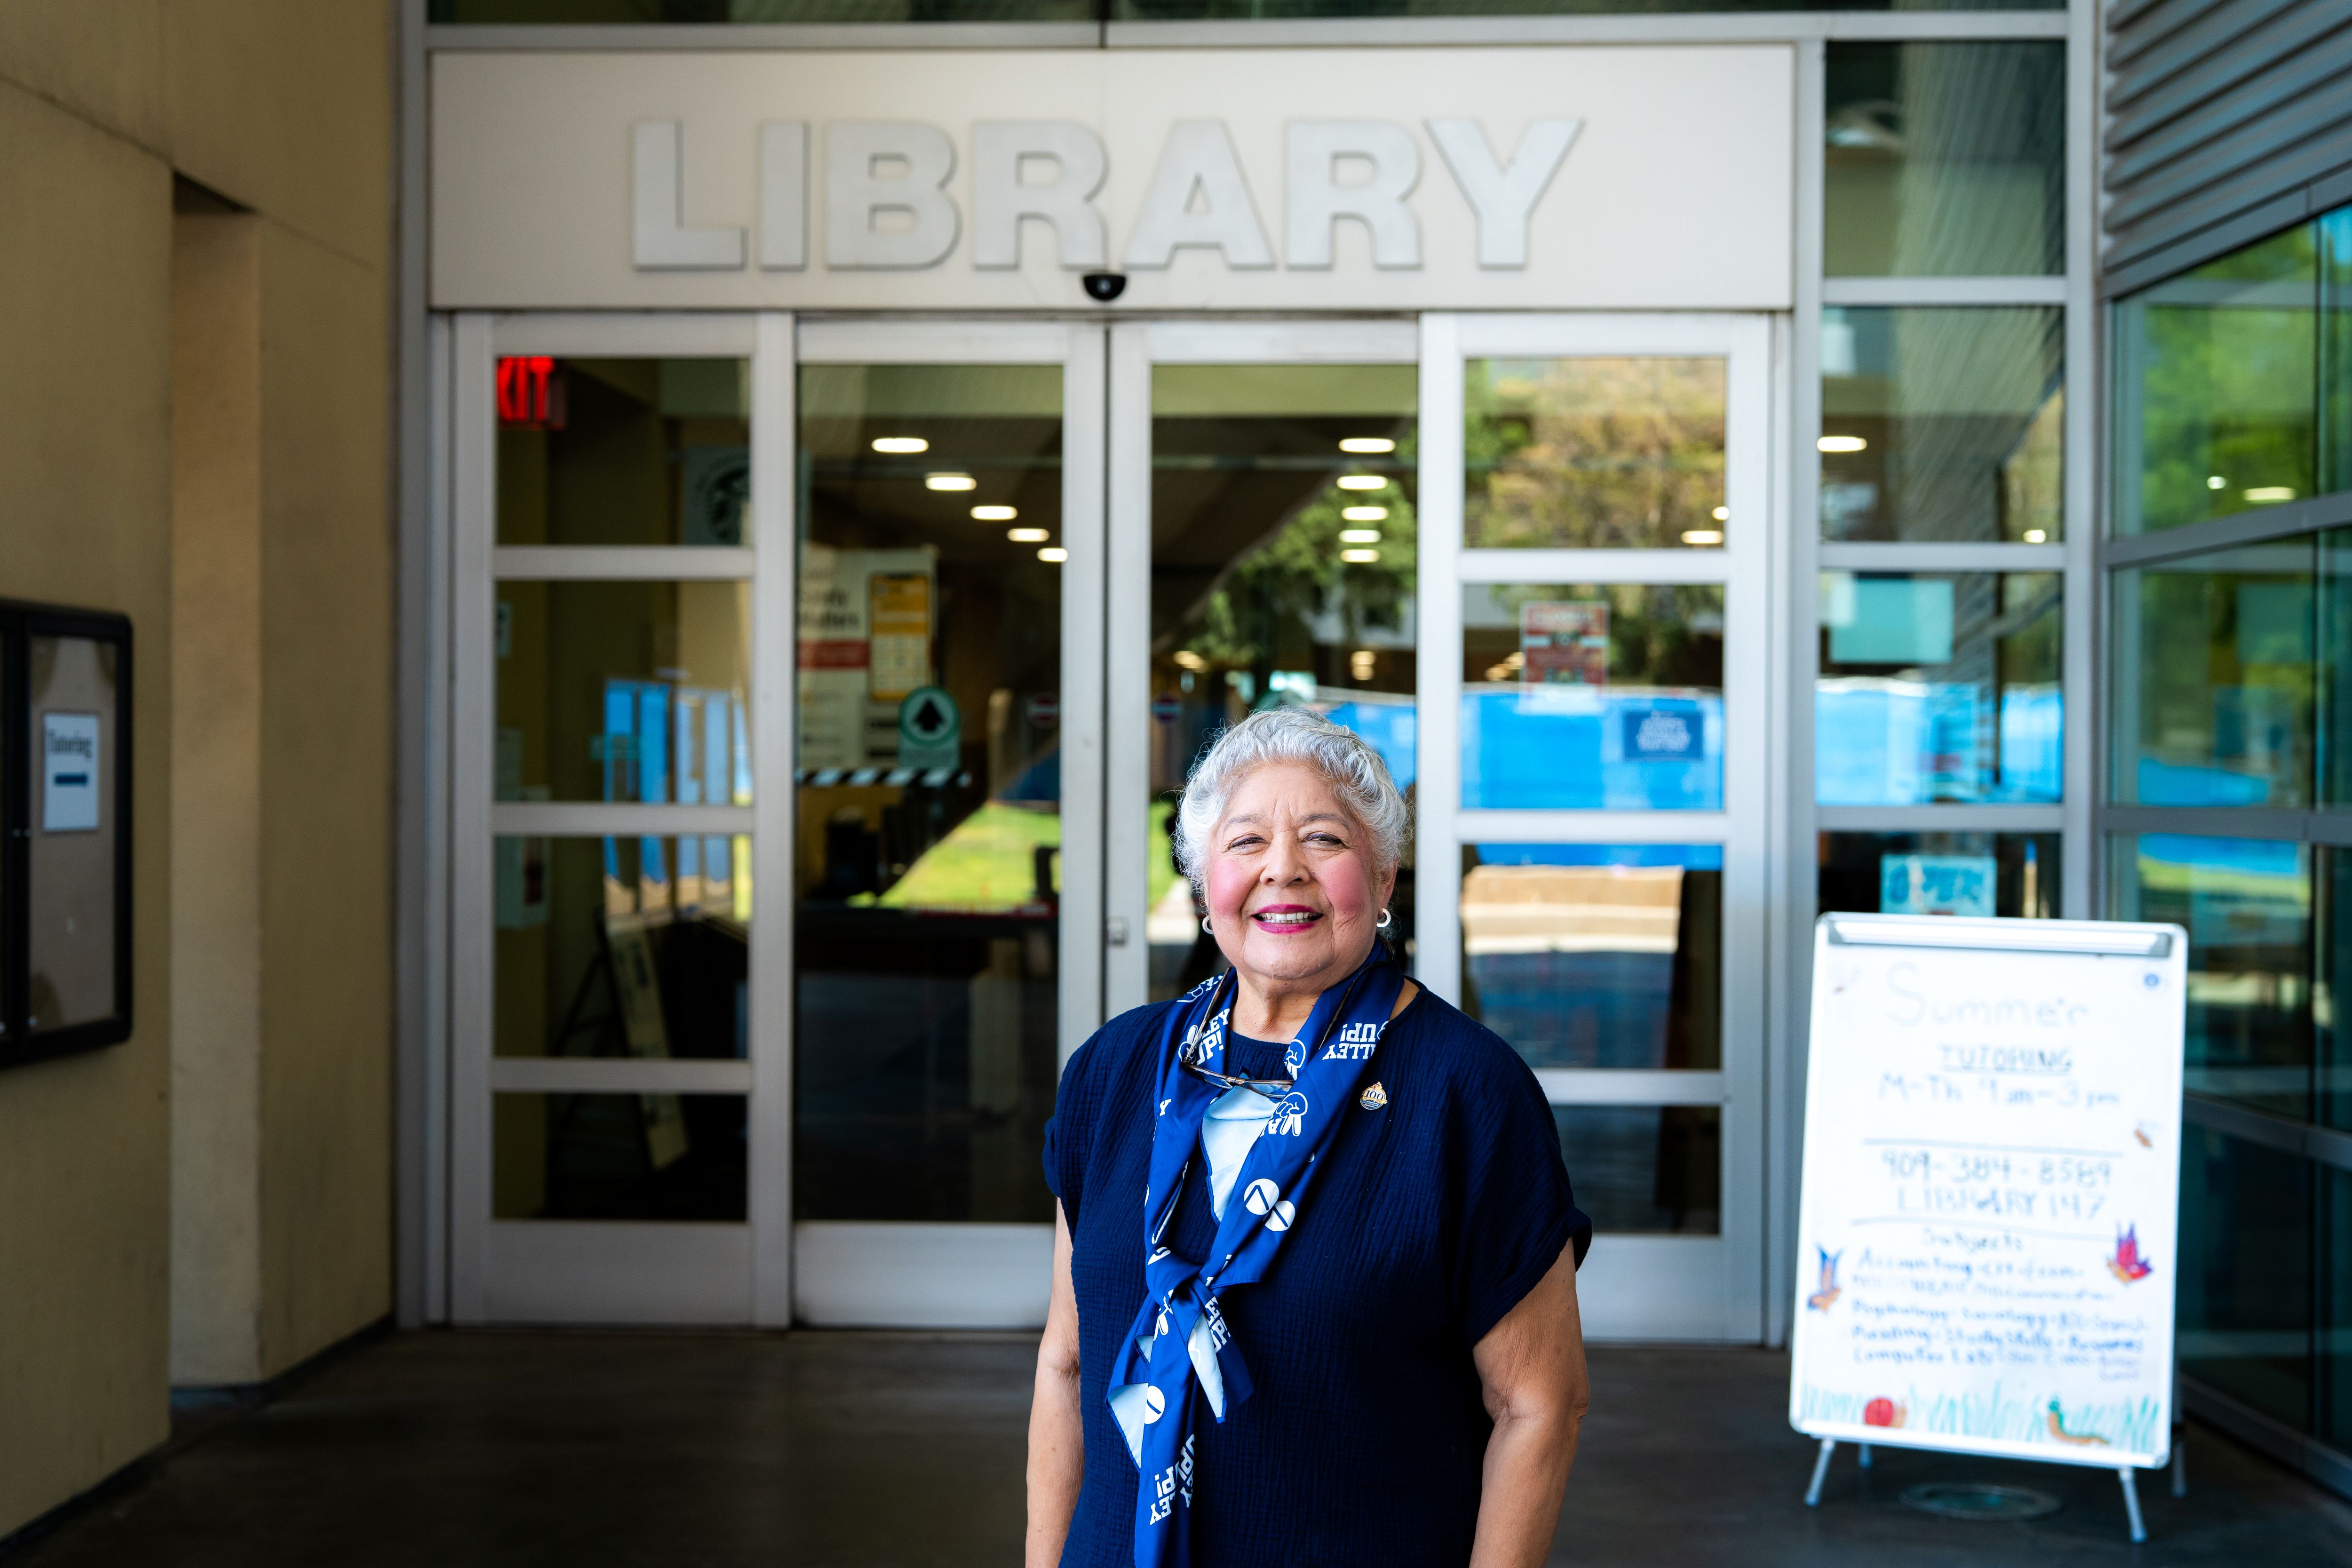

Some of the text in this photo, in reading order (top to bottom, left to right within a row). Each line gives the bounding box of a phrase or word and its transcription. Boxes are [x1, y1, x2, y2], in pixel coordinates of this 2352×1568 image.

[631, 119, 1586, 272] LIBRARY
[1885, 961, 2090, 1027] Summer
[1340, 1023, 1376, 1042] UP!
[1938, 1043, 2074, 1072] TUTORING
